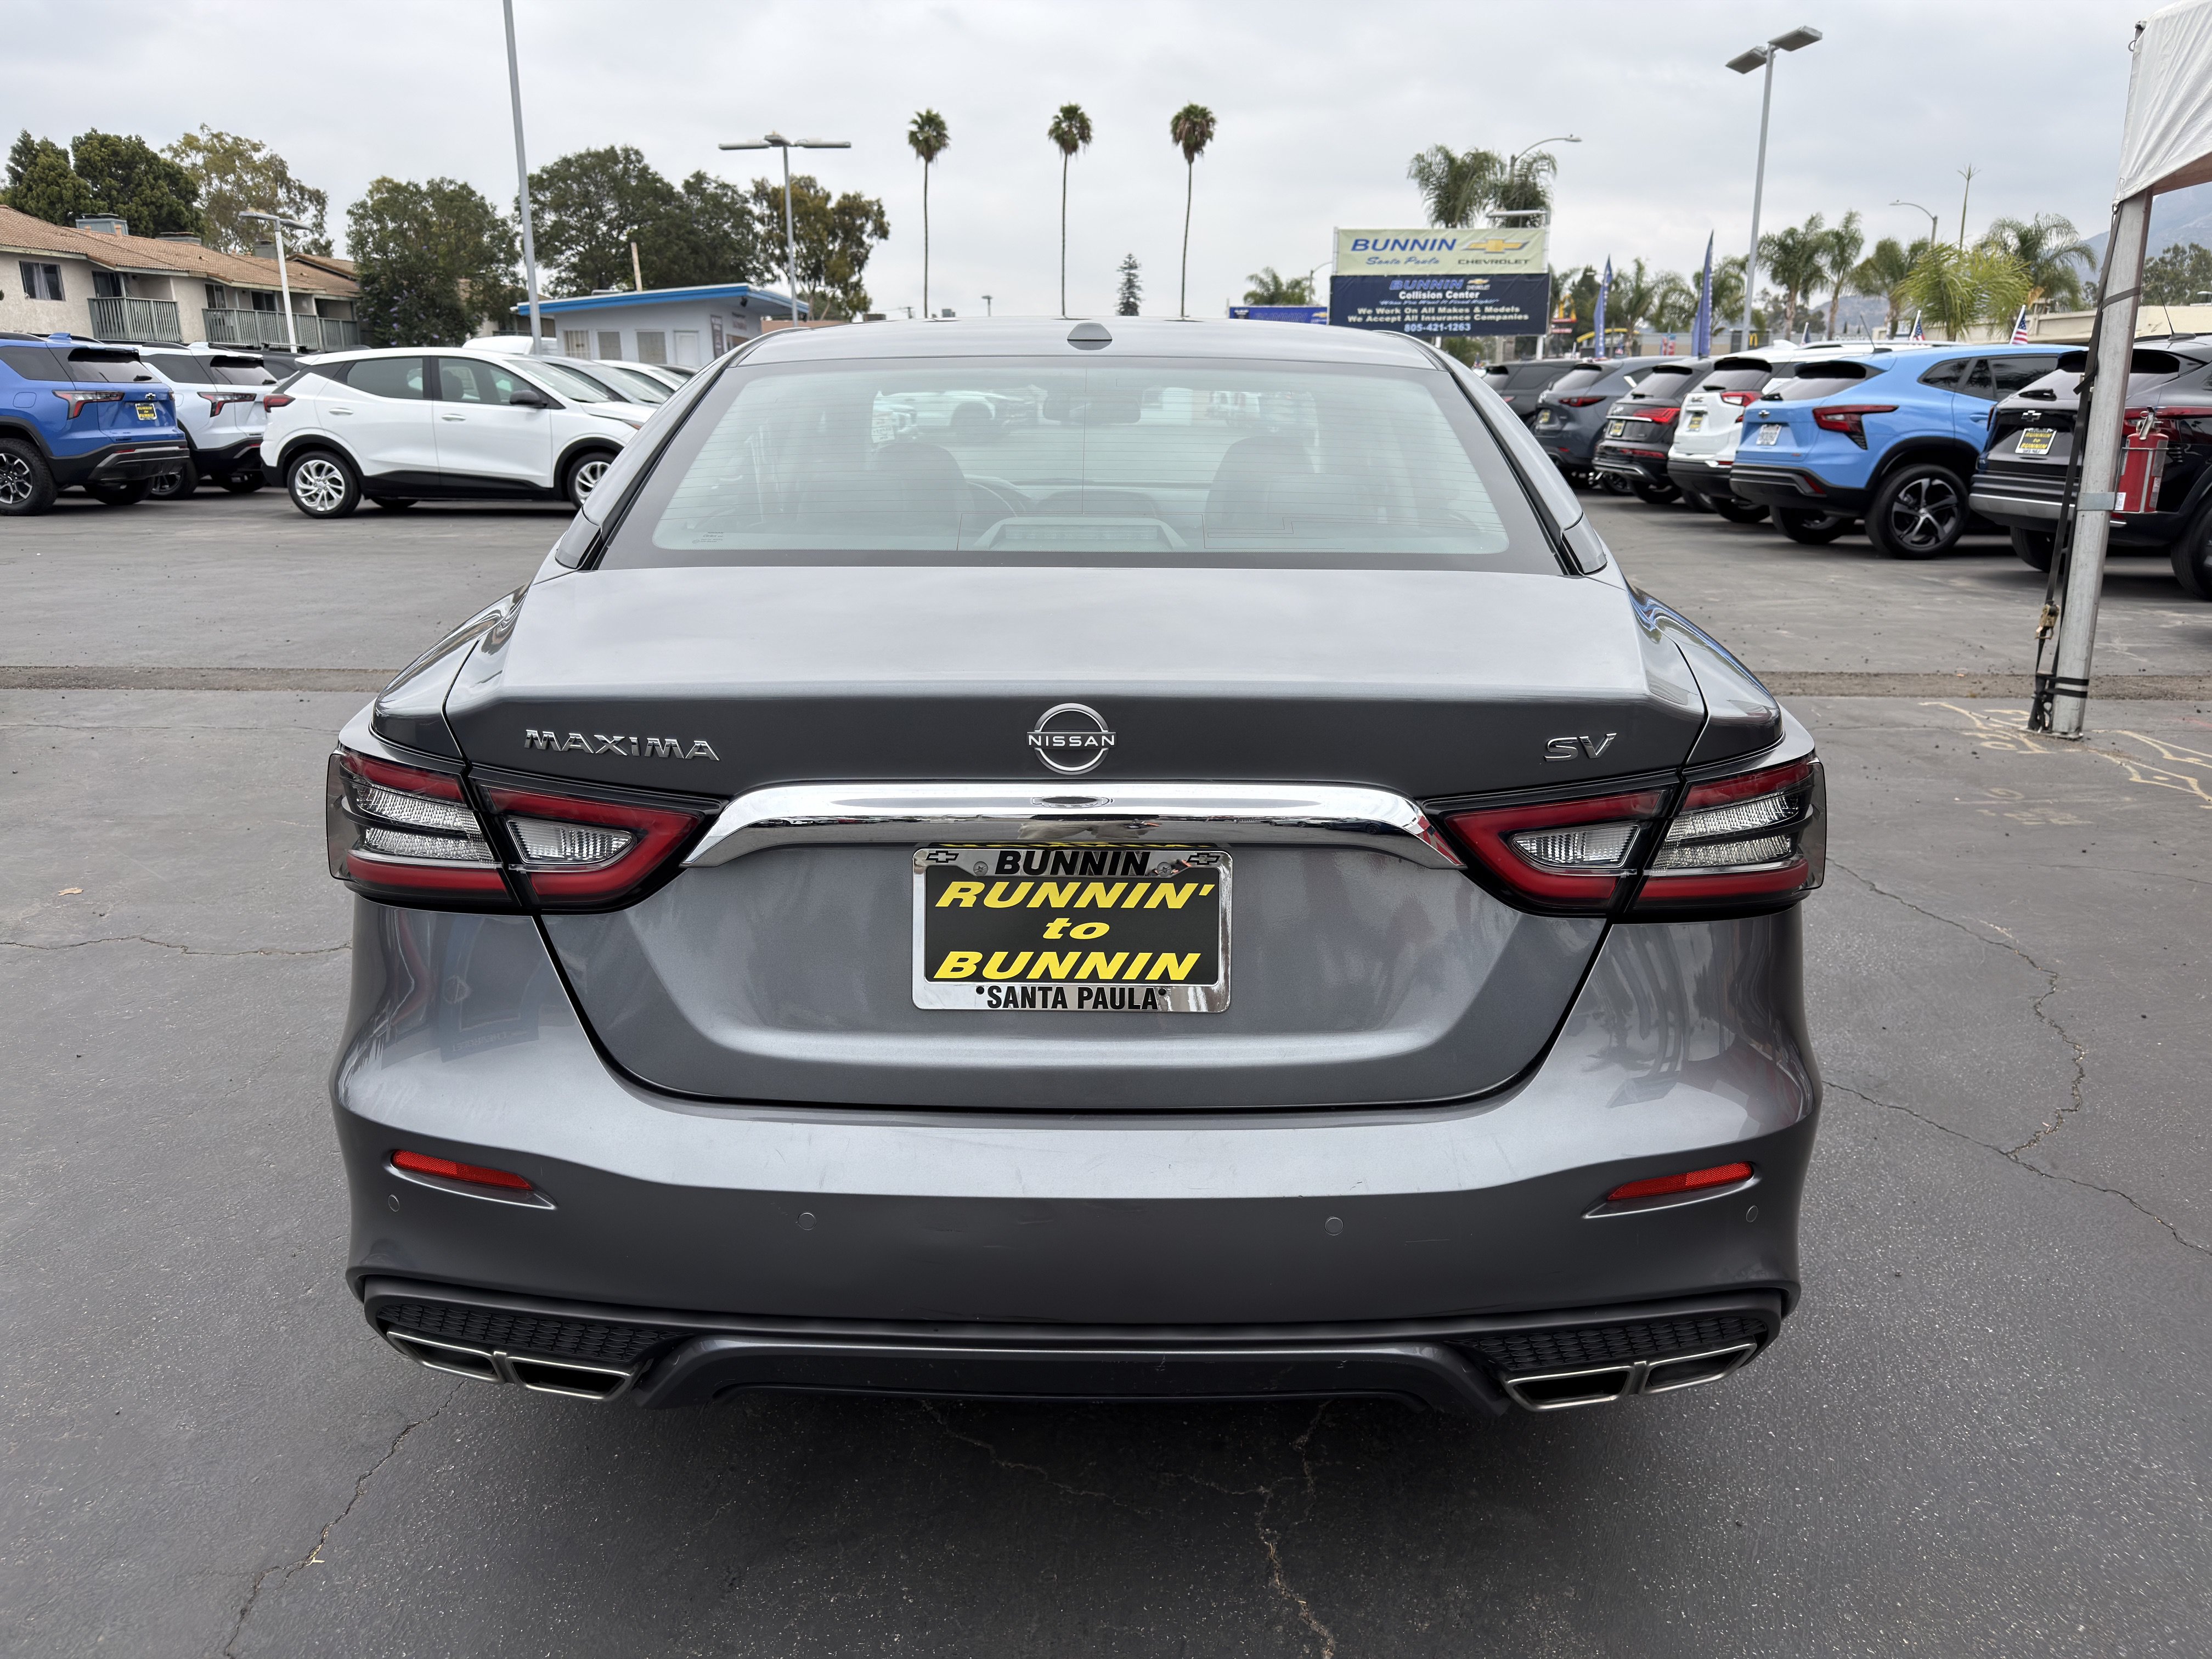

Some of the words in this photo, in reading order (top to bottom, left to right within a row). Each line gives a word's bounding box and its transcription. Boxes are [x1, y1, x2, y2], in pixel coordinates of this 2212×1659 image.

[1351, 238, 1457, 251] BUNNIN
[1365, 256, 1401, 265] Santa
[1404, 256, 1440, 264] Paula
[1389, 279, 1464, 290] BUNNIN
[1399, 291, 1443, 300] Collision
[1446, 290, 1480, 299] Center
[1365, 315, 1402, 323] Accept
[1474, 313, 1530, 321] Companies
[1404, 323, 1471, 332] 805-421-1263
[524, 729, 720, 761] MAXIMA
[1028, 735, 1115, 747] NISSAN
[1543, 733, 1617, 762] SV
[995, 851, 1150, 876] BUNNIN
[935, 882, 1215, 909] RUNNIN'
[1043, 918, 1110, 939] to
[933, 951, 1201, 980] BUNNIN
[988, 986, 1068, 1009] SANTA
[1078, 986, 1158, 1010] PAULA
